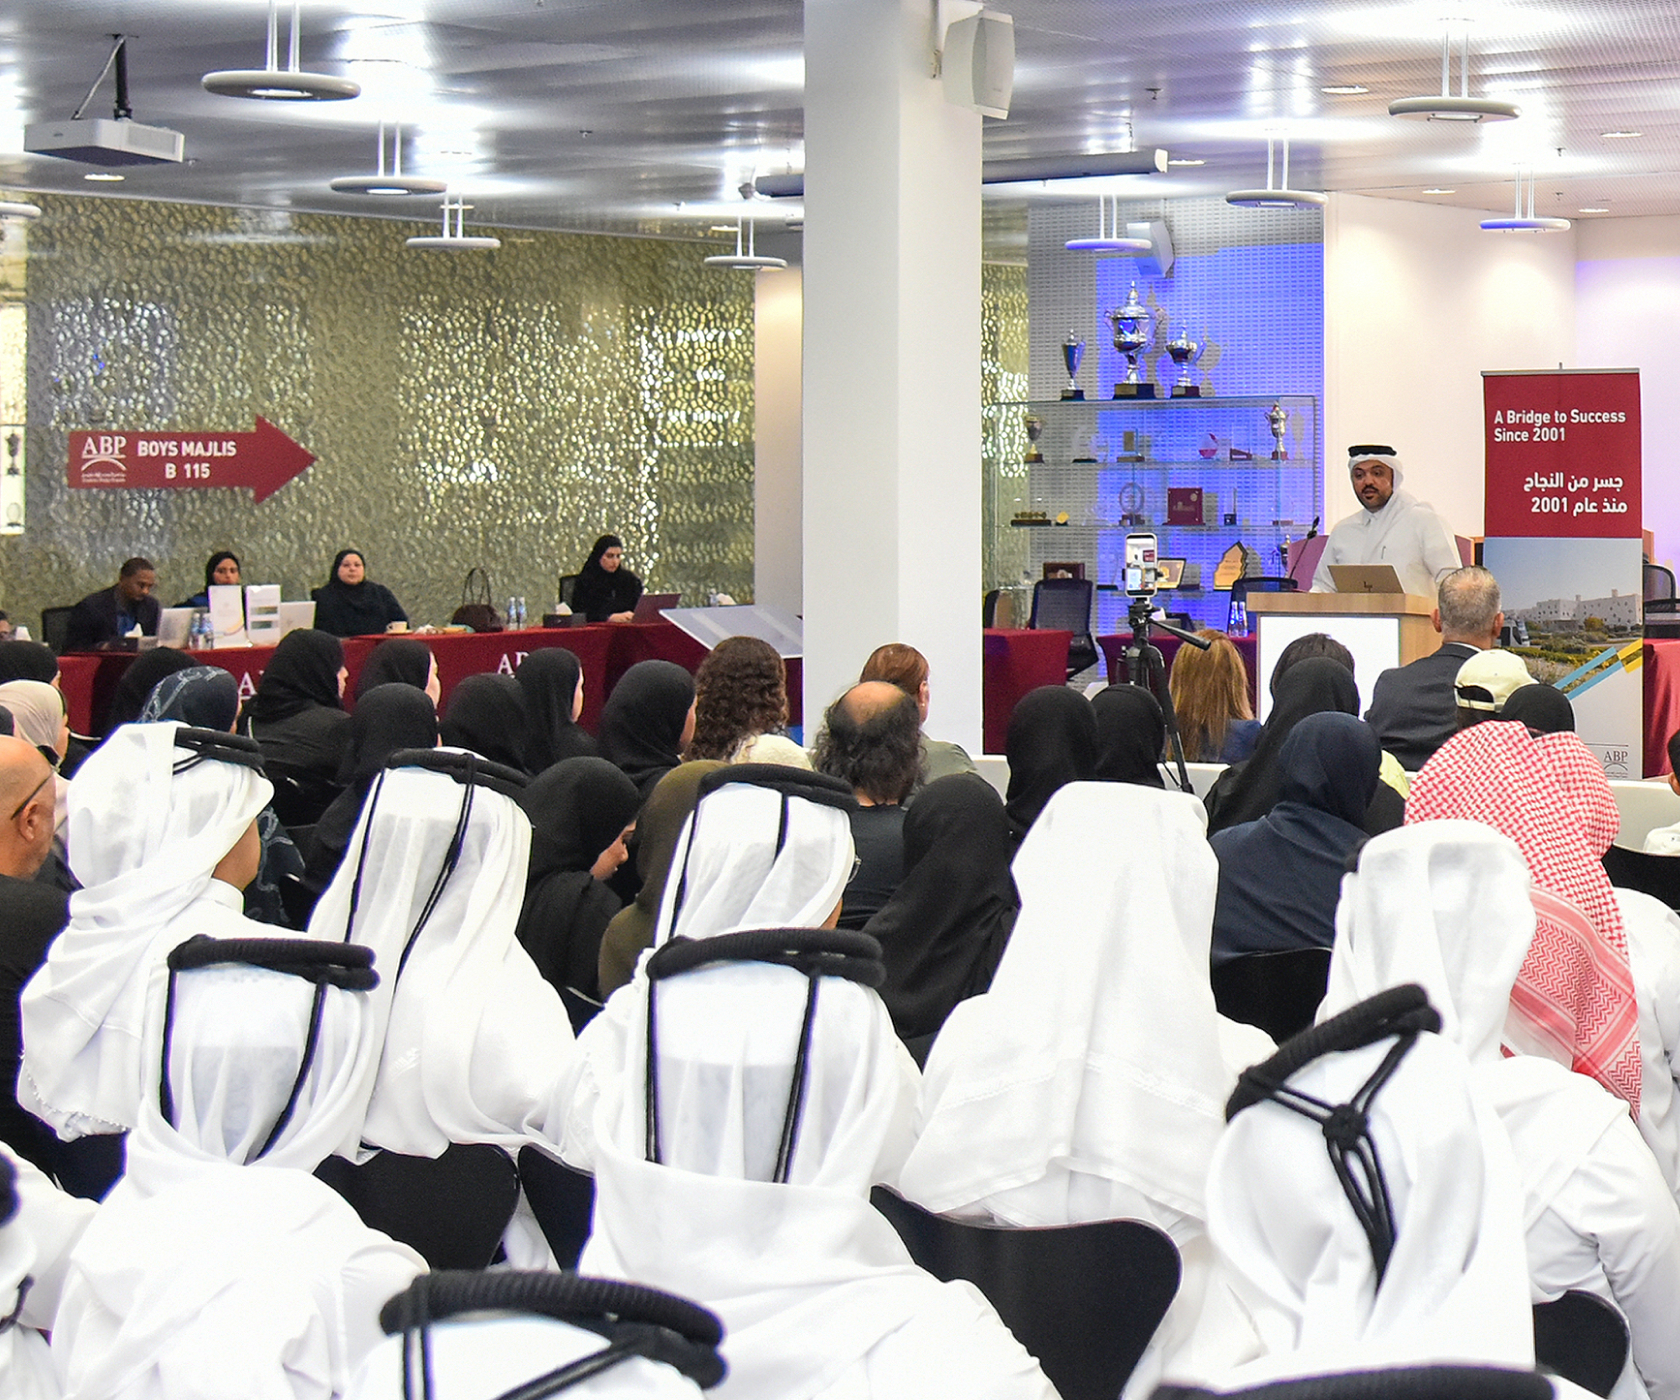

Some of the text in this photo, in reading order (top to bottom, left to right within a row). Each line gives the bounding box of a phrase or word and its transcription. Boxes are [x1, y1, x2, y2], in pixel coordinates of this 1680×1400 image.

[1494, 409, 1626, 426] A Bridge to Success
[1494, 427, 1566, 442] Since 2001
[82, 435, 127, 455] ABP
[137, 440, 237, 457] BOYS MAJLIS
[165, 462, 211, 479] B 115
[1523, 472, 1623, 492] جسر من النجاح
[1531, 496, 1628, 517] منذ عام 2001
[1603, 750, 1628, 762] ABP
